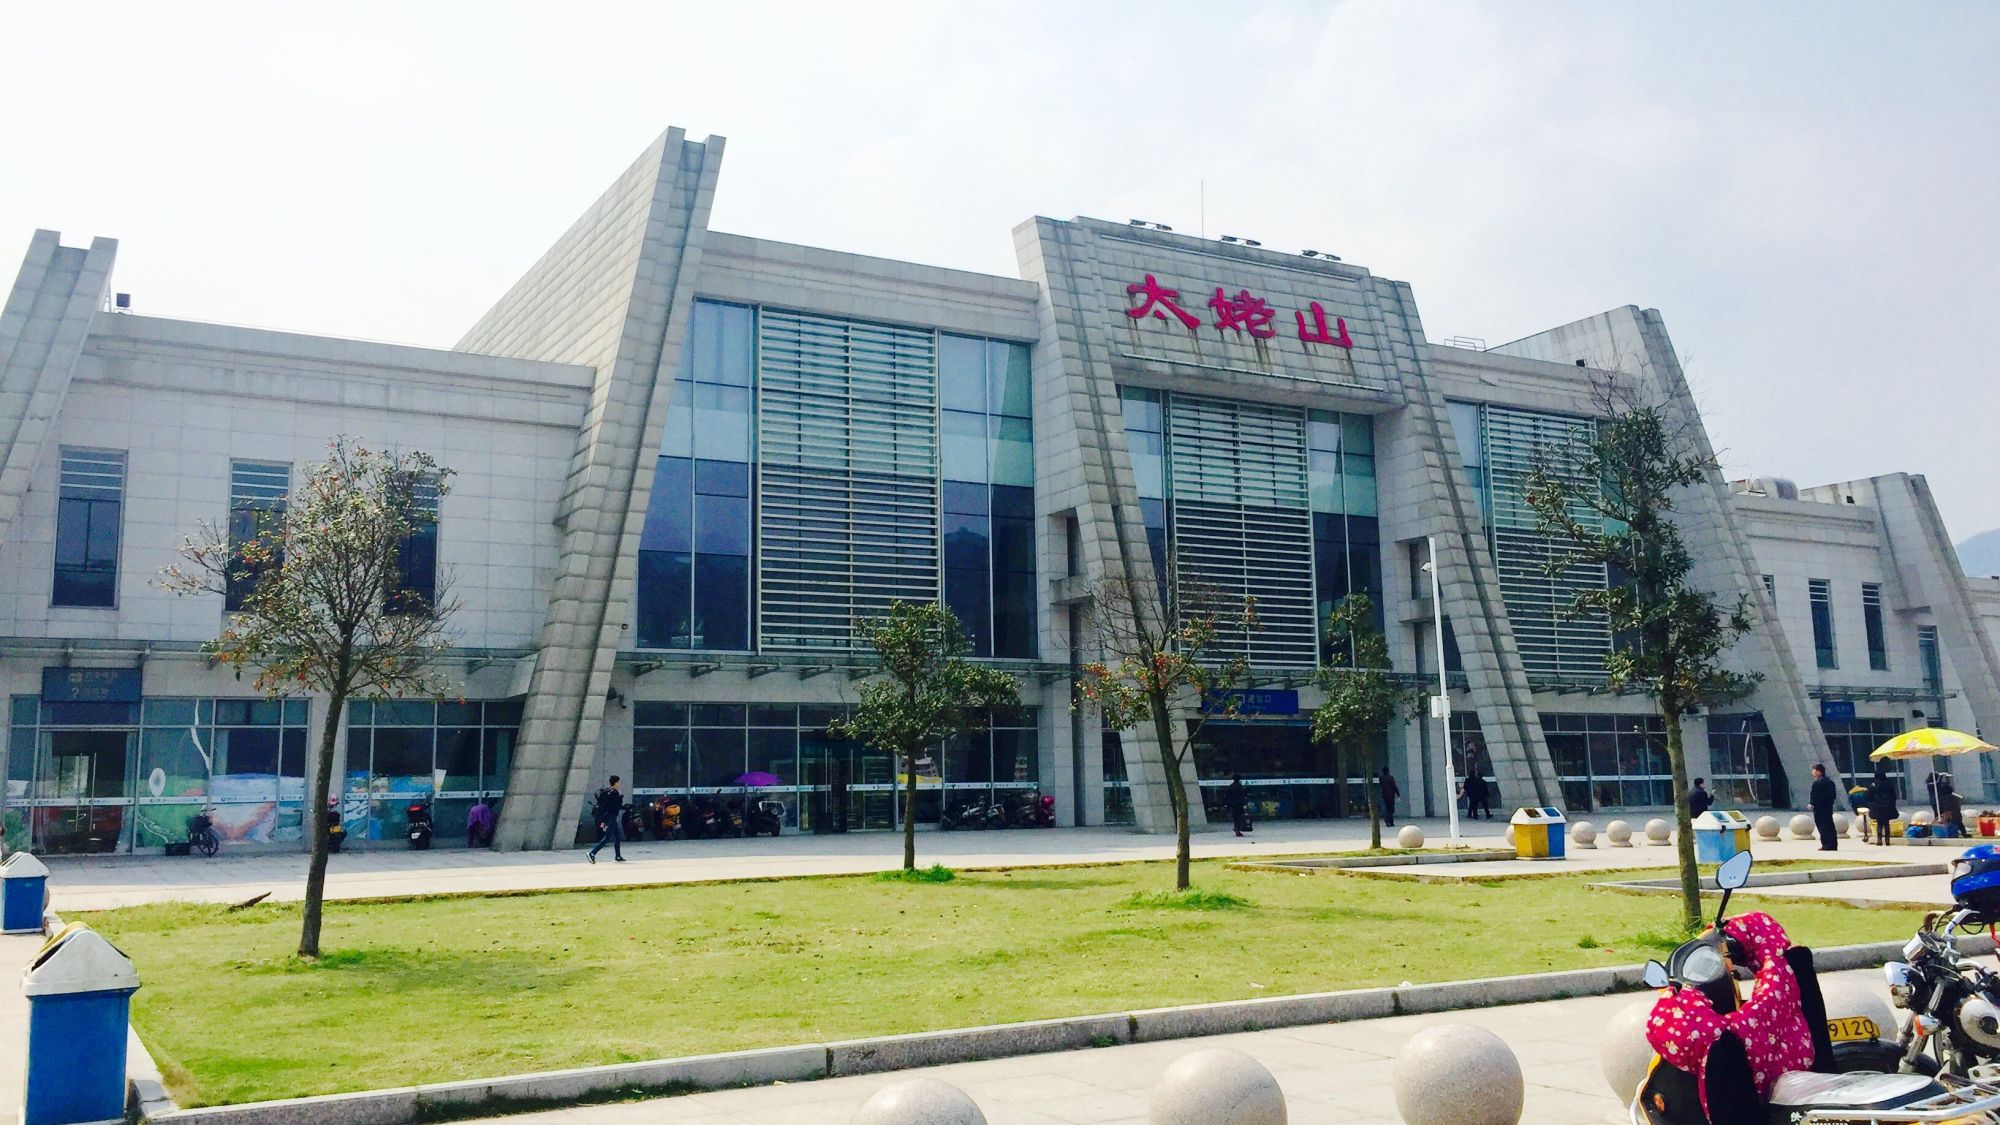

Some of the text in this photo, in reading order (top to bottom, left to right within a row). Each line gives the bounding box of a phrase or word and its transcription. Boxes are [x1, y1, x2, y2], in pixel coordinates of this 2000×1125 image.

[1126, 274, 1353, 349] 太姥山
[1828, 1019, 1875, 1037] 9120
